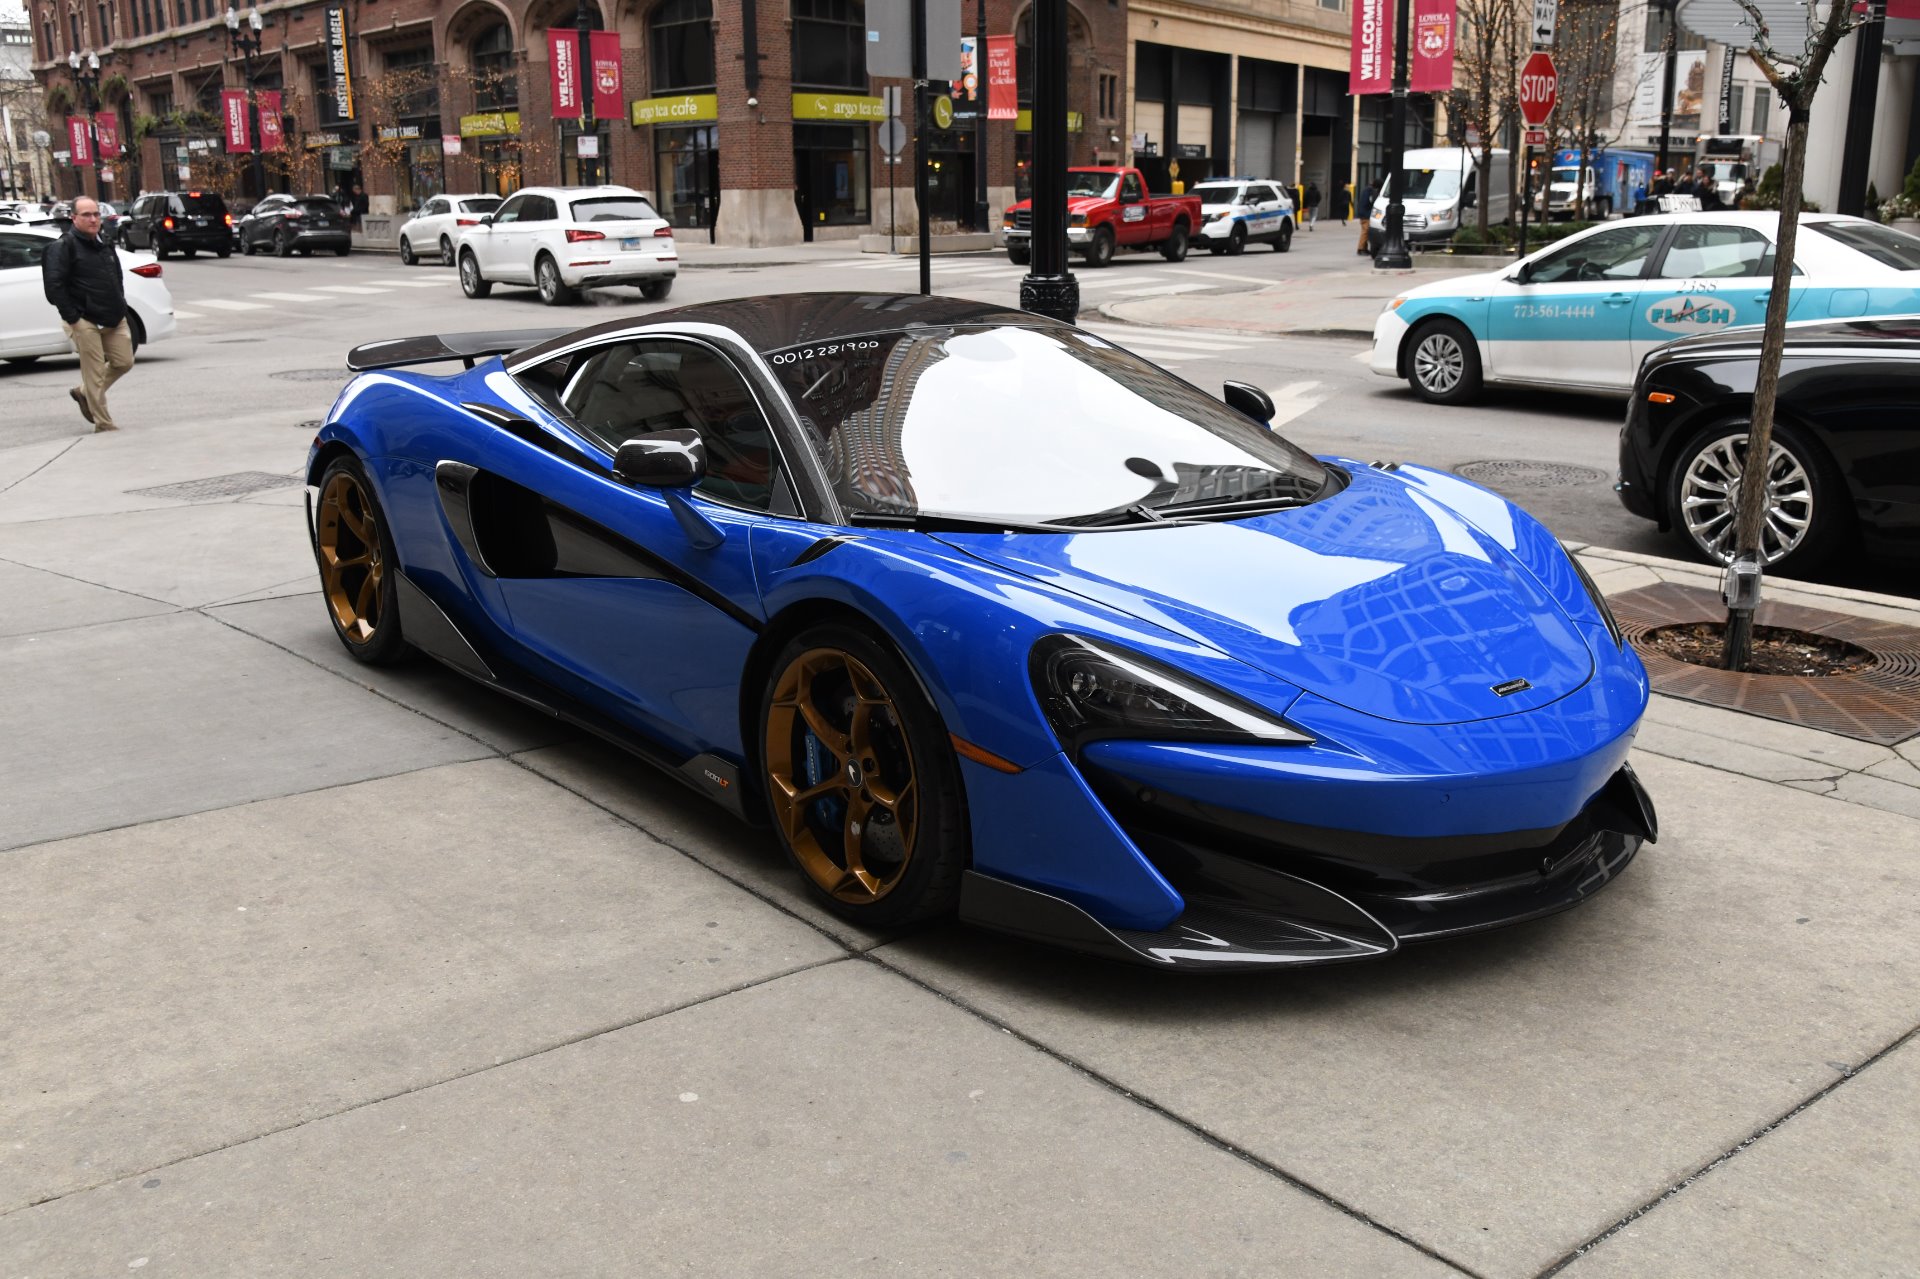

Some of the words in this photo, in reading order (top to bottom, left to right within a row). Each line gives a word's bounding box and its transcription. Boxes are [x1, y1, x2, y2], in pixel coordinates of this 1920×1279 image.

[1376, 0, 1384, 26] CAMPU
[1419, 13, 1450, 23] LOYOLA
[1536, 7, 1555, 20] WAY
[330, 9, 343, 46] BAGELS
[1361, 0, 1375, 80] WELCOME
[1375, 27, 1383, 53] TOWER
[556, 40, 569, 107] WELCOME
[1374, 54, 1382, 80] WATER
[1720, 46, 1734, 98] ORDSTROM
[336, 76, 350, 118] EINSTEIN
[1521, 75, 1555, 102] STOP
[655, 105, 669, 117] tea
[671, 96, 698, 116] café
[834, 102, 858, 118] argo
[859, 102, 872, 115] tea
[1719, 100, 1730, 124] rack
[228, 98, 241, 145] WELCOME
[73, 122, 85, 160] WELCOME
[1676, 279, 1719, 294] 2388
[1513, 304, 1596, 319] 773-561-4444
[1651, 298, 1730, 324] FLASH
[773, 341, 879, 364] 0012281900
